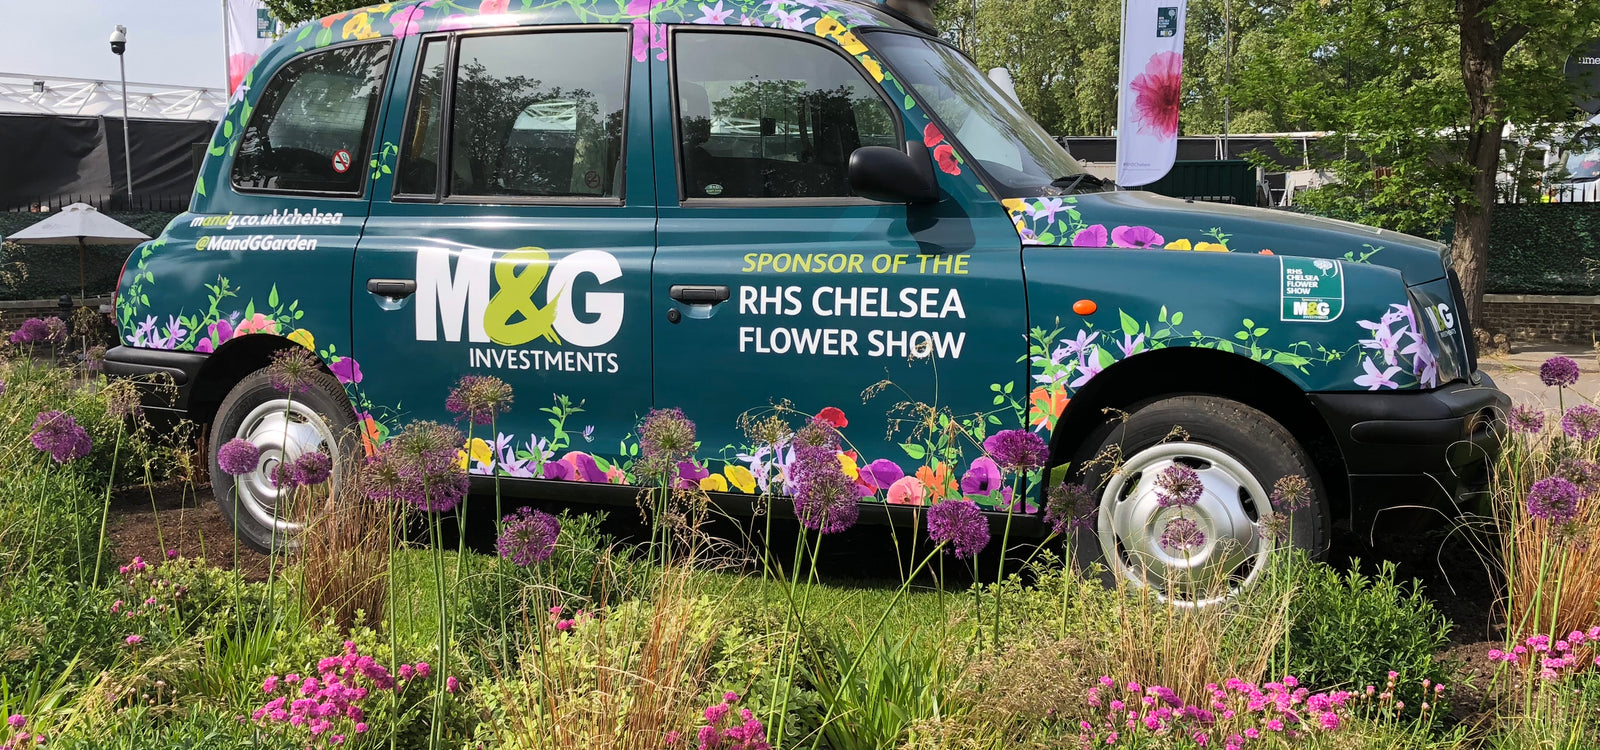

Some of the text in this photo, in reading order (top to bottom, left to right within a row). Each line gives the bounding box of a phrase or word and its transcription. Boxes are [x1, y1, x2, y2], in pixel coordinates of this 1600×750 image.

[189, 208, 344, 230] mandg.co.uk/chelsea
[195, 234, 318, 251] @MandGGarden
[742, 252, 971, 274] SPONSOR OF THE
[1286, 280, 1319, 288] FLOWER
[1286, 287, 1311, 295] SHOW
[415, 246, 625, 347] M&G
[739, 285, 966, 319] RHS CHELSEA
[1293, 301, 1330, 316] M&G
[739, 326, 966, 359] FLOWER SHOW
[469, 347, 619, 374] INVESTMENTS
